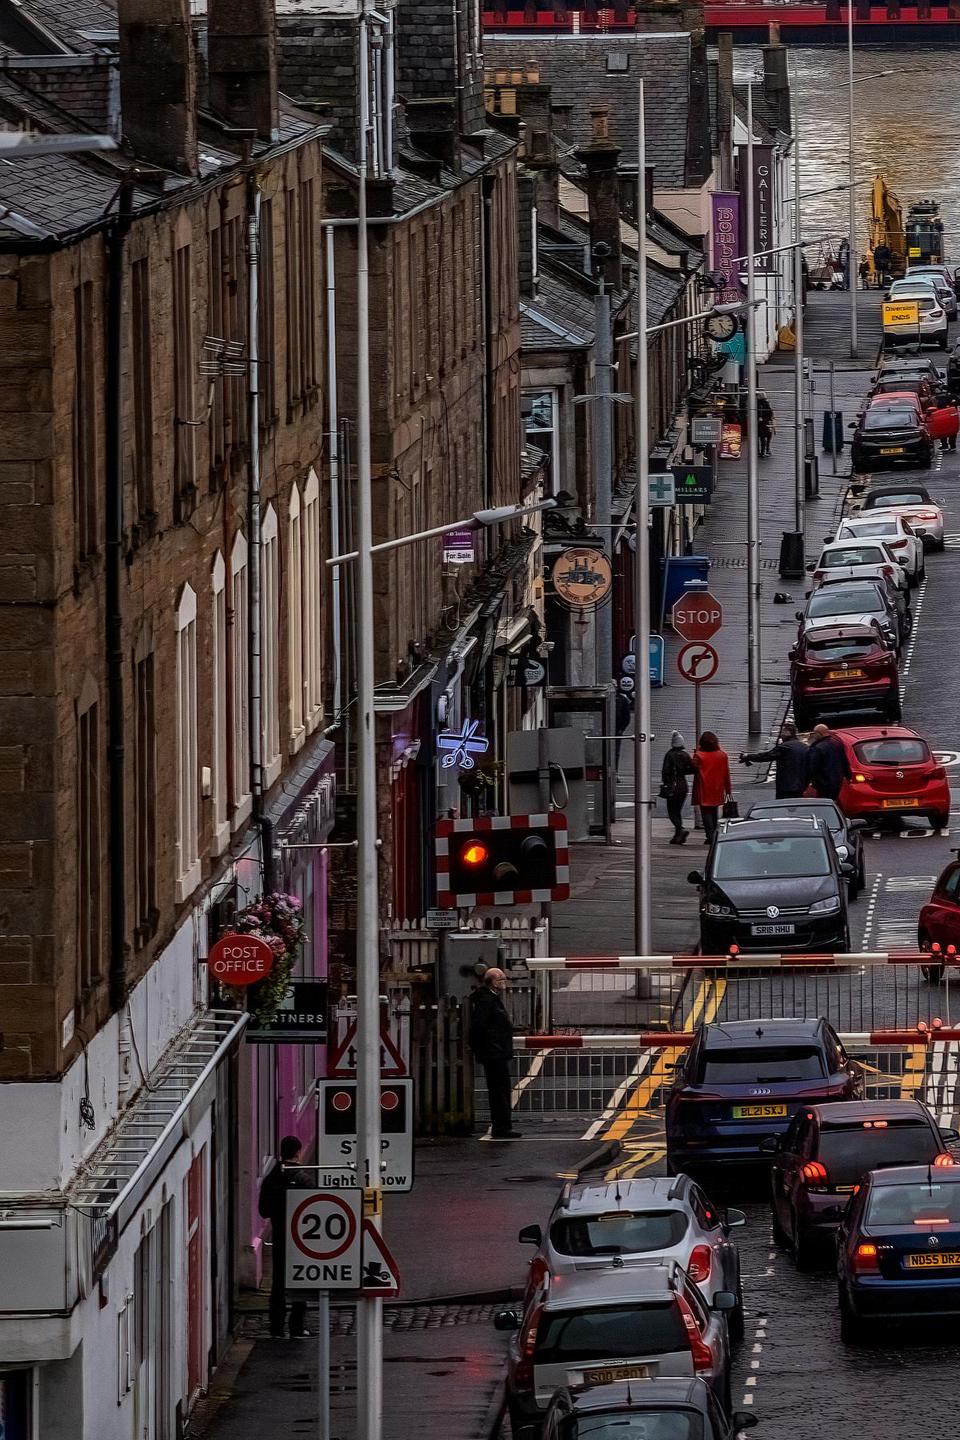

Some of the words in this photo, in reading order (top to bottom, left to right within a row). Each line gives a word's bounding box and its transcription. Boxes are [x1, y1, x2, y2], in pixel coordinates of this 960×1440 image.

[758, 165, 769, 253] GALLERY
[676, 610, 721, 625] STOP
[223, 946, 260, 959] POST
[214, 959, 265, 973] OFFICE
[249, 1013, 324, 1025] PRTNERS
[741, 1107, 763, 1116] BL21
[764, 1106, 784, 1115] SXJ
[302, 1213, 347, 1241] 20
[292, 1265, 353, 1281] ZONE
